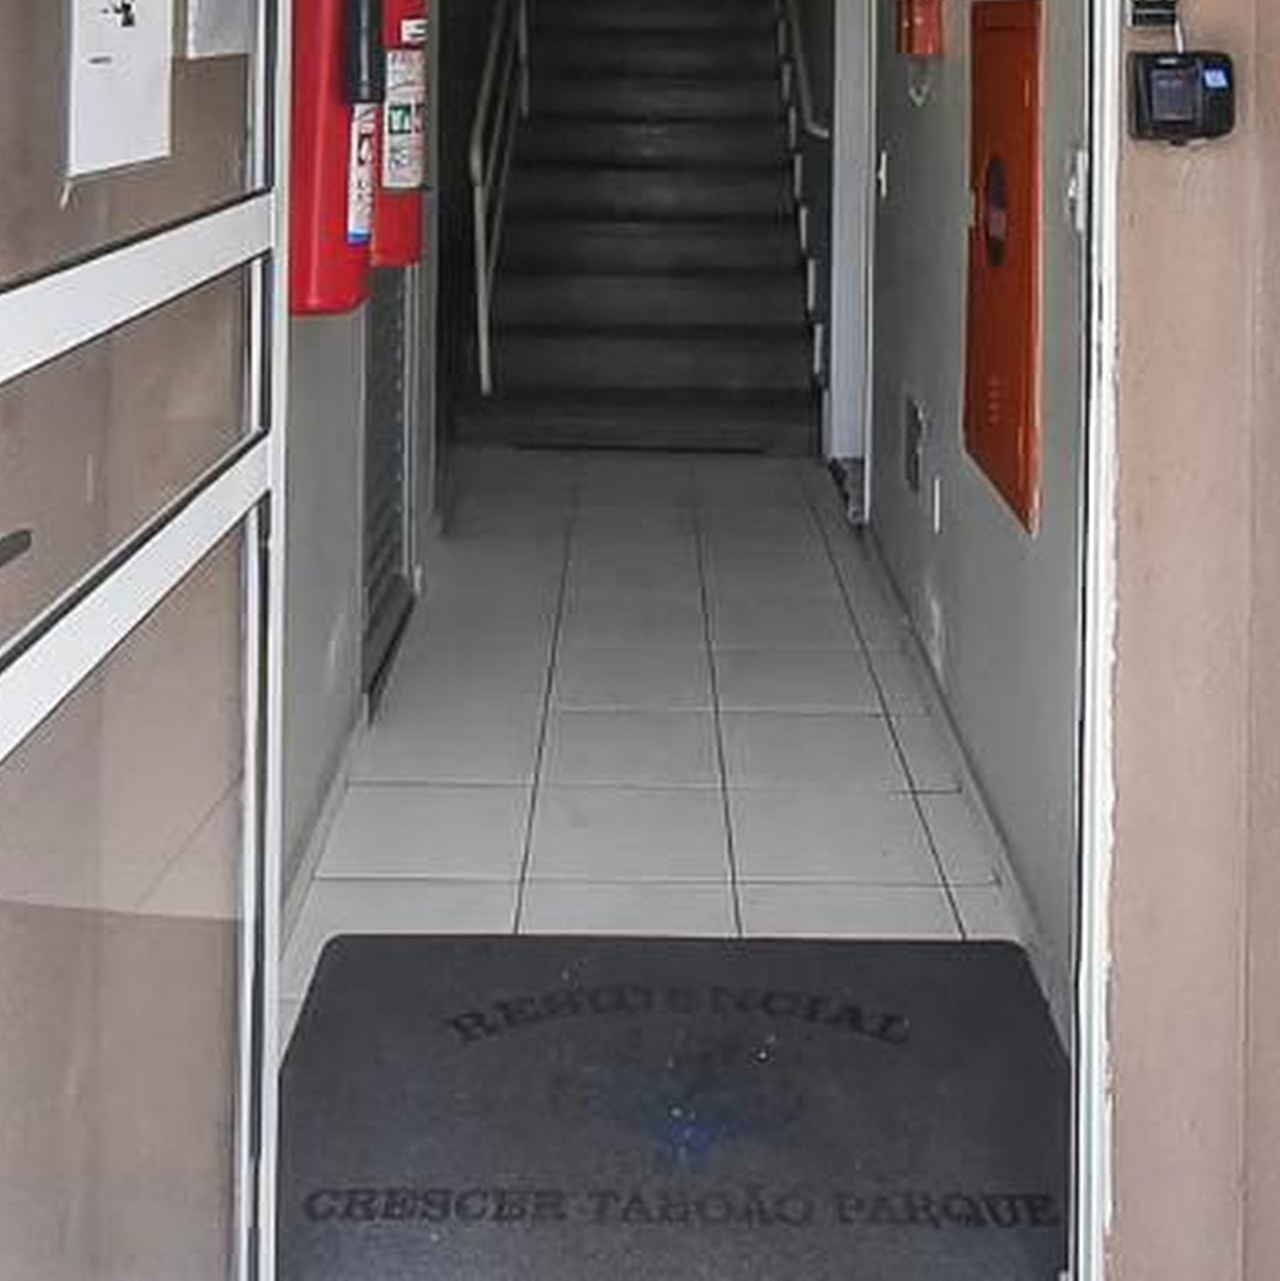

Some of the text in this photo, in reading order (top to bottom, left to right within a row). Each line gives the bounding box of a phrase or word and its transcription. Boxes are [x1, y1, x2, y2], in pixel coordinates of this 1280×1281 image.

[448, 985, 910, 1045] RESIDENCIAL
[304, 1187, 568, 1221] CRESCER
[836, 1191, 1060, 1227] PARQUE
